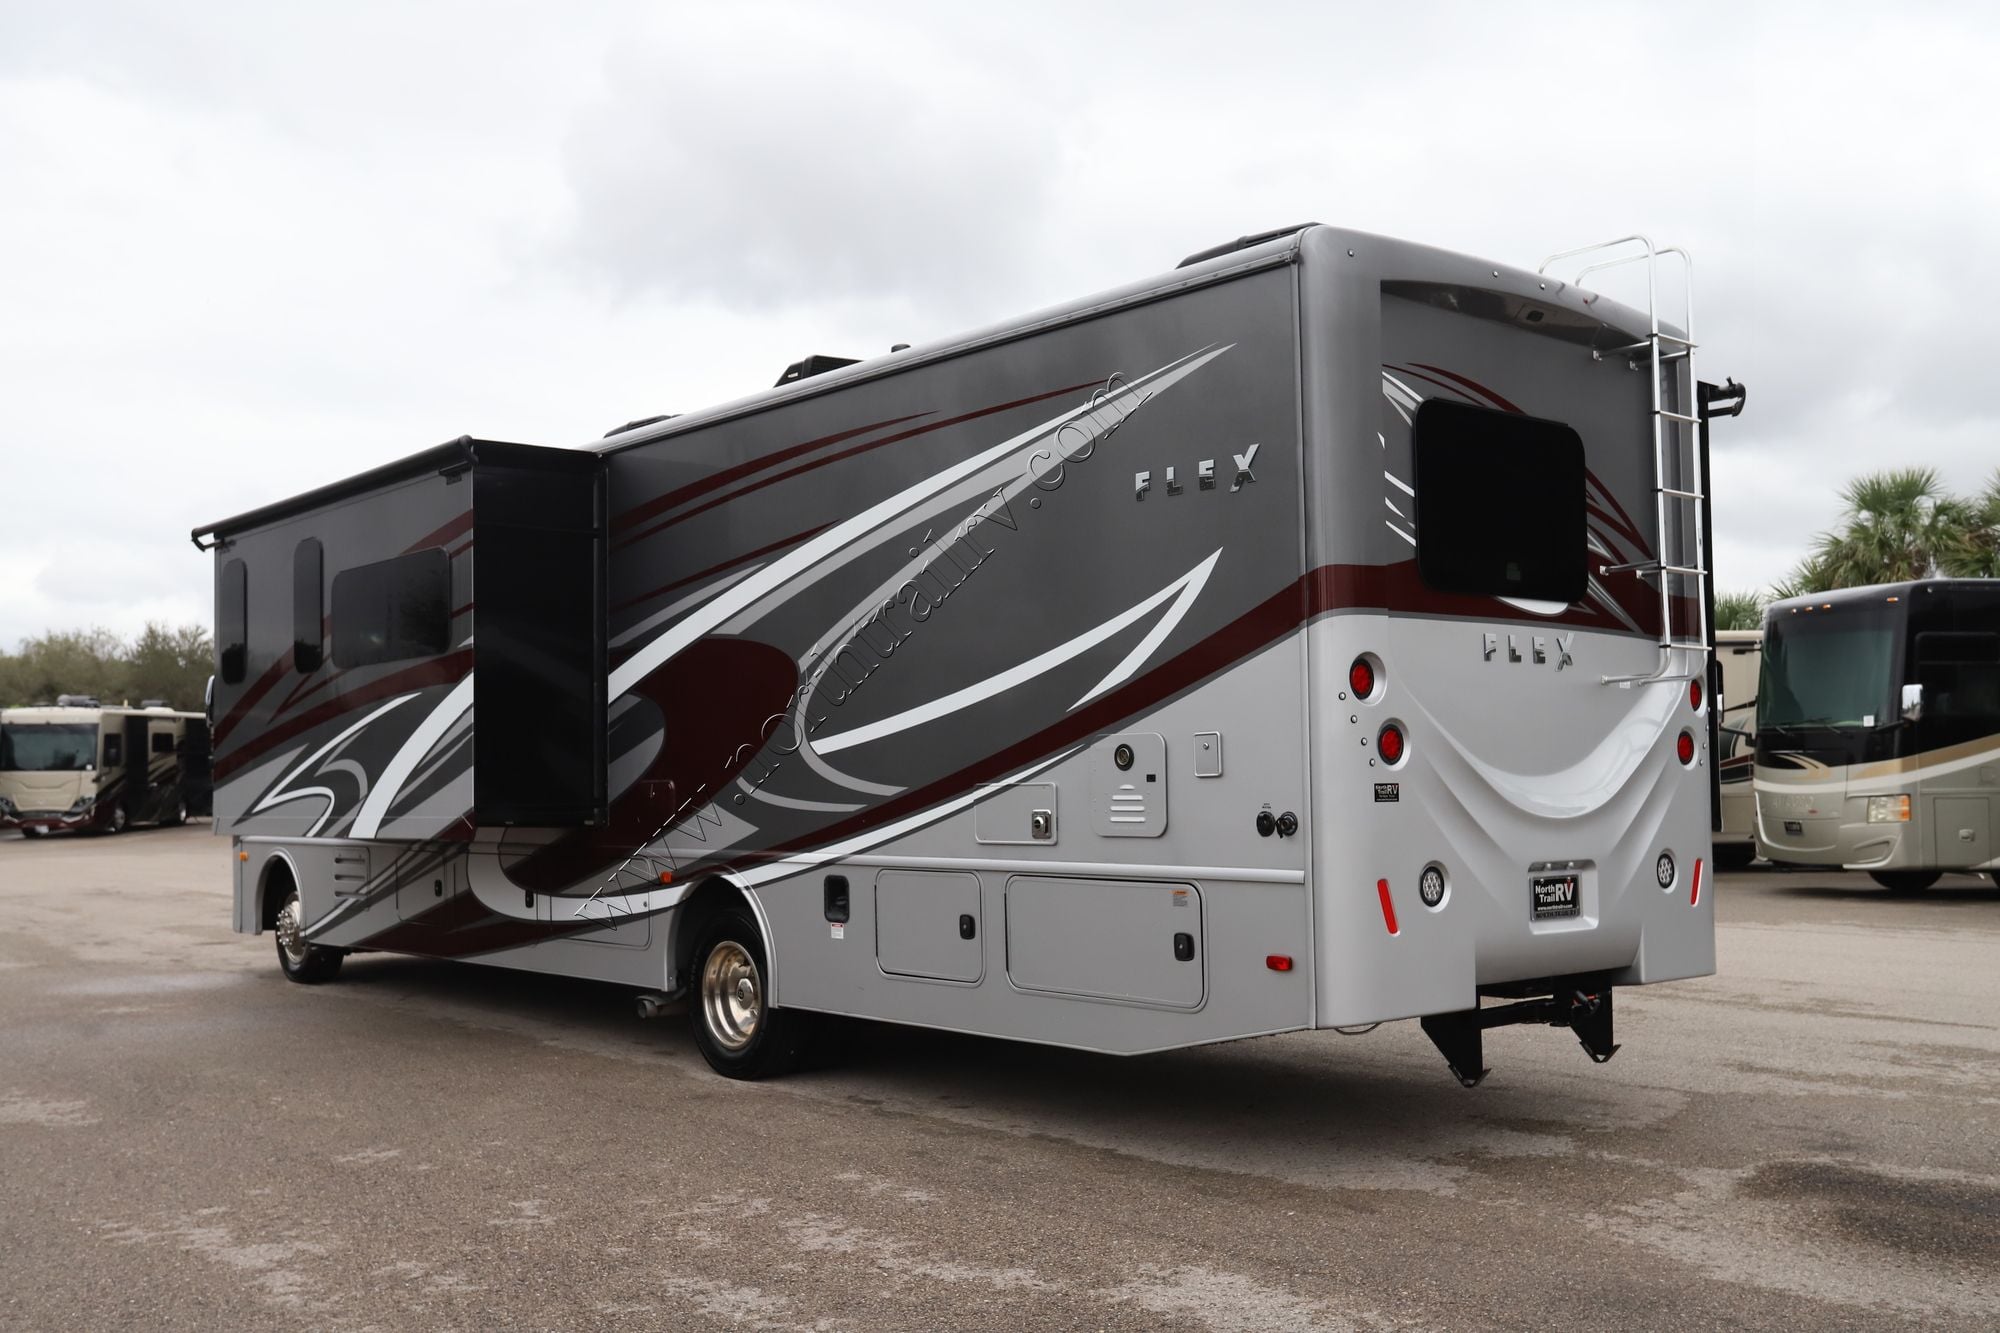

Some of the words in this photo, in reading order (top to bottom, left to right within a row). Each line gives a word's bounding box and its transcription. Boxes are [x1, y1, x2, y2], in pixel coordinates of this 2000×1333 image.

[1135, 443, 1260, 502] FLEX
[1483, 631, 1575, 672] FLEX
[1387, 785, 1398, 795] RV
[1535, 884, 1555, 894] North
[1555, 883, 1574, 901] RV
[1539, 894, 1555, 902] Trail
